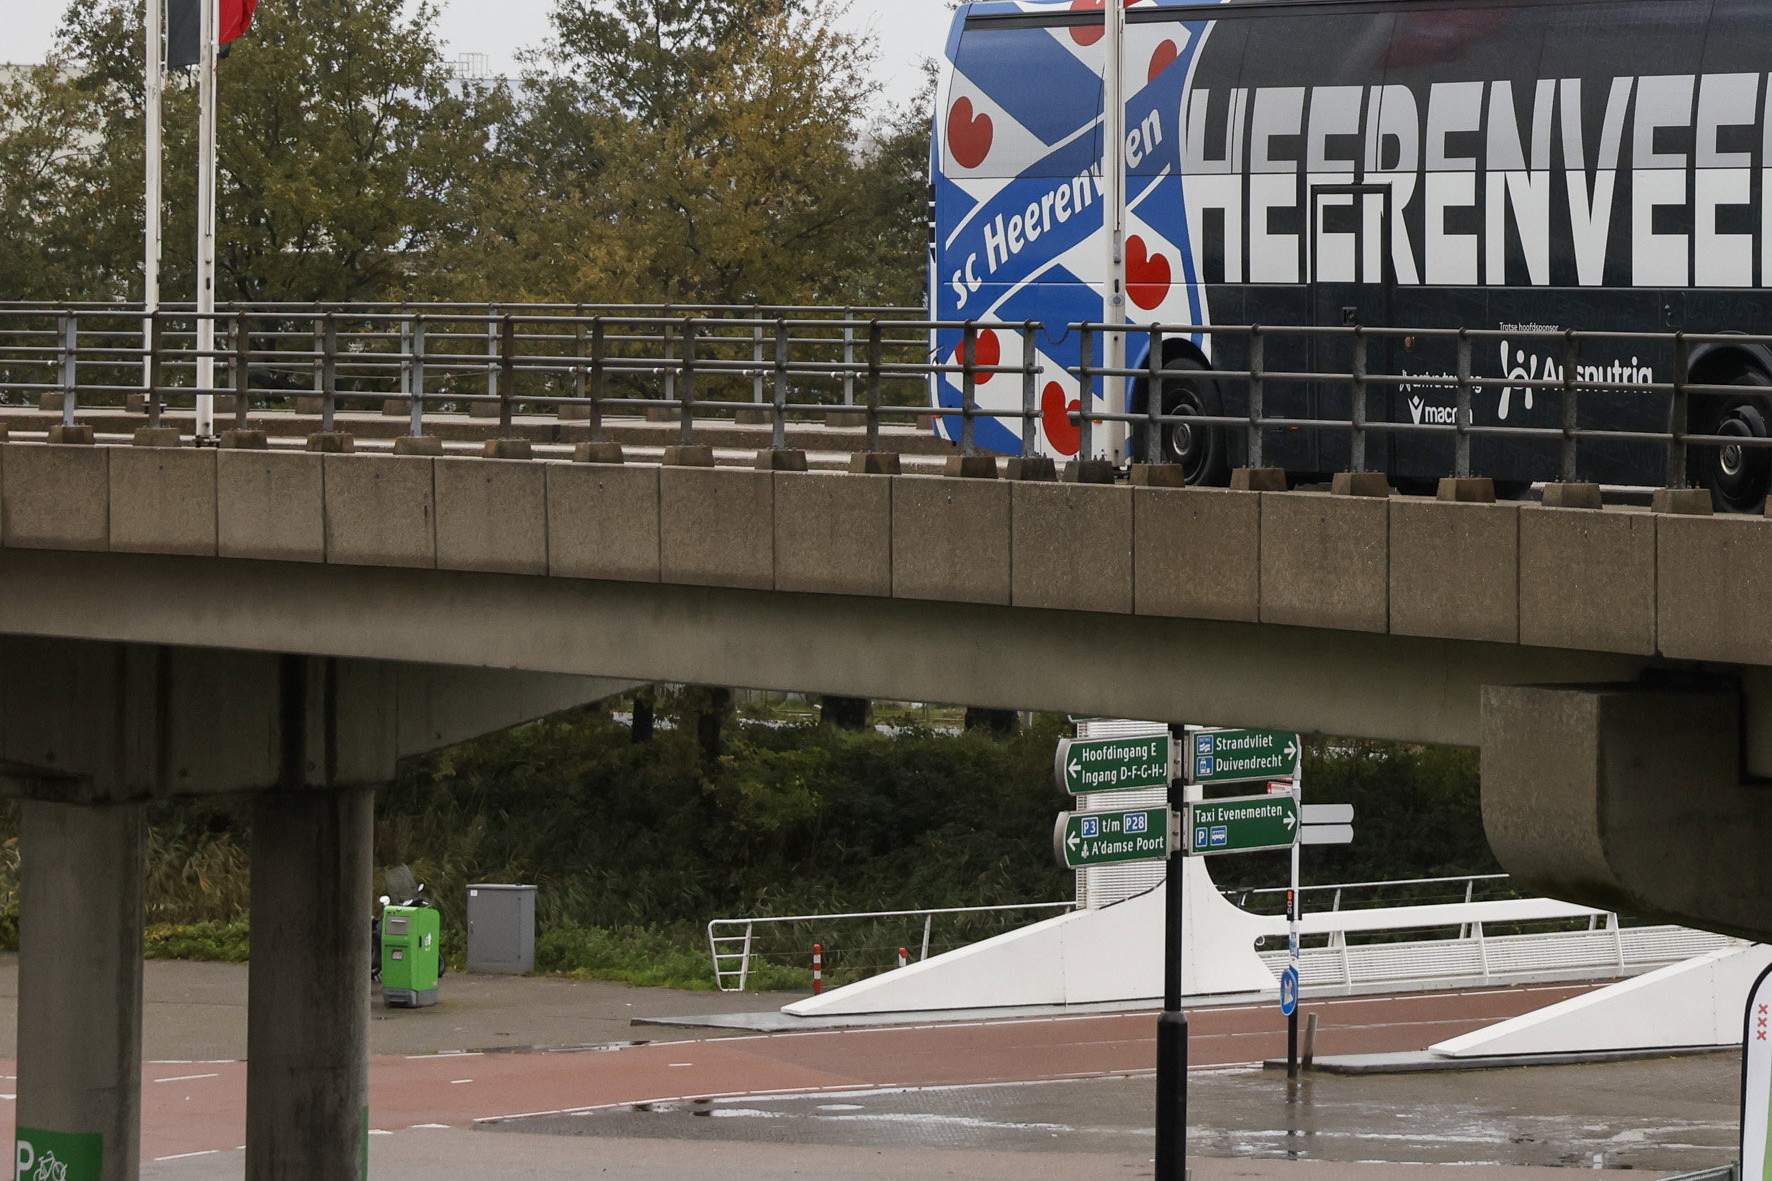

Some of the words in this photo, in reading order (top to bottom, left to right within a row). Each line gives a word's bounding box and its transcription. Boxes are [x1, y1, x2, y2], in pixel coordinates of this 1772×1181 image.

[952, 252, 983, 310] sc
[983, 108, 1163, 274] Heerenven
[1499, 321, 1518, 332] Trotse
[1518, 321, 1559, 333] hoofdsponsor
[1082, 743, 1149, 762] Hoofdingang
[1150, 742, 1157, 756] E
[1216, 735, 1273, 751] Strandvliet
[1216, 754, 1282, 772] Duivendrecht
[1081, 768, 1117, 786] Ingang
[1120, 763, 1168, 780] D-F-G-H-J
[1195, 808, 1215, 823] Taxi
[1218, 804, 1282, 822] Evenementen
[1083, 818, 1097, 835] P3
[1102, 817, 1120, 833] t/m
[1125, 815, 1145, 831] P28
[1091, 838, 1134, 855] A'damse
[1137, 835, 1164, 851] Poort
[1197, 830, 1205, 845] P
[16, 1140, 34, 1181] P
